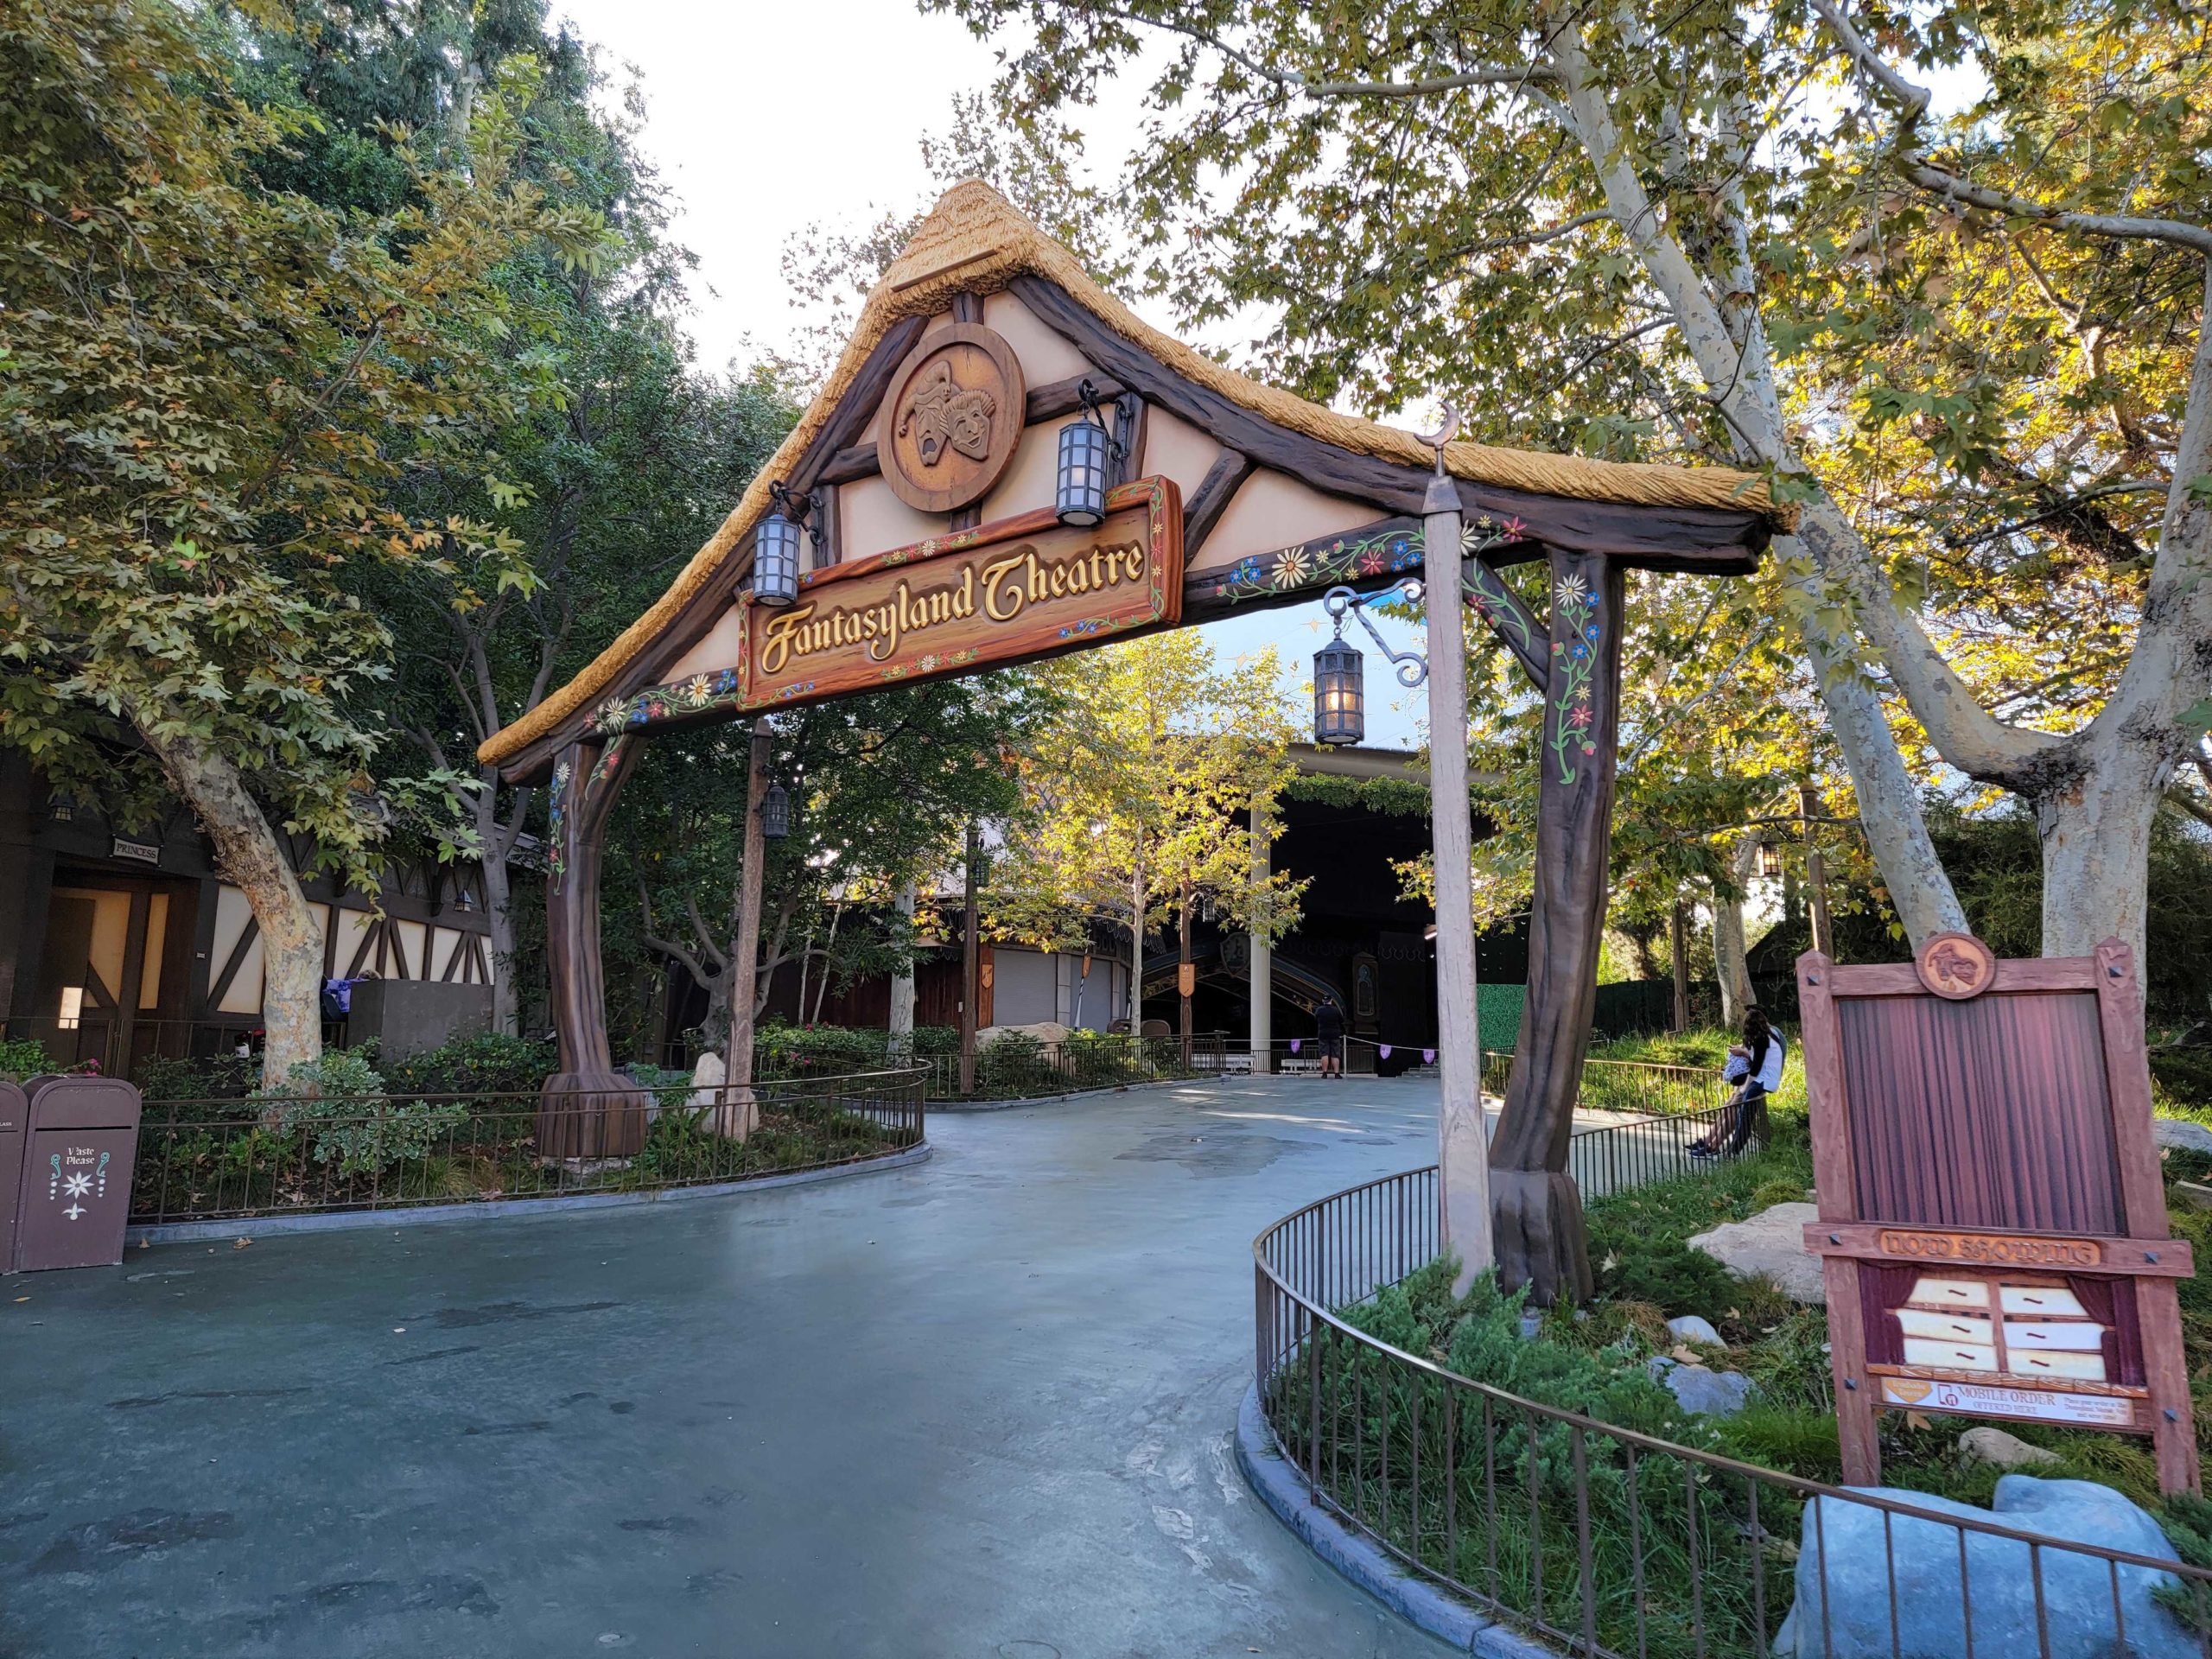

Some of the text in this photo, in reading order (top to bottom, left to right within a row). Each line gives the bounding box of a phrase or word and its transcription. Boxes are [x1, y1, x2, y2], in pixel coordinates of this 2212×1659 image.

[761, 545, 1145, 673] Fantasyland Theatre
[117, 842, 156, 859] PRINCESS
[67, 1156, 95, 1166] Please
[1957, 1386, 2007, 1402] MOBILE
[2010, 1390, 2056, 1406] ORDER
